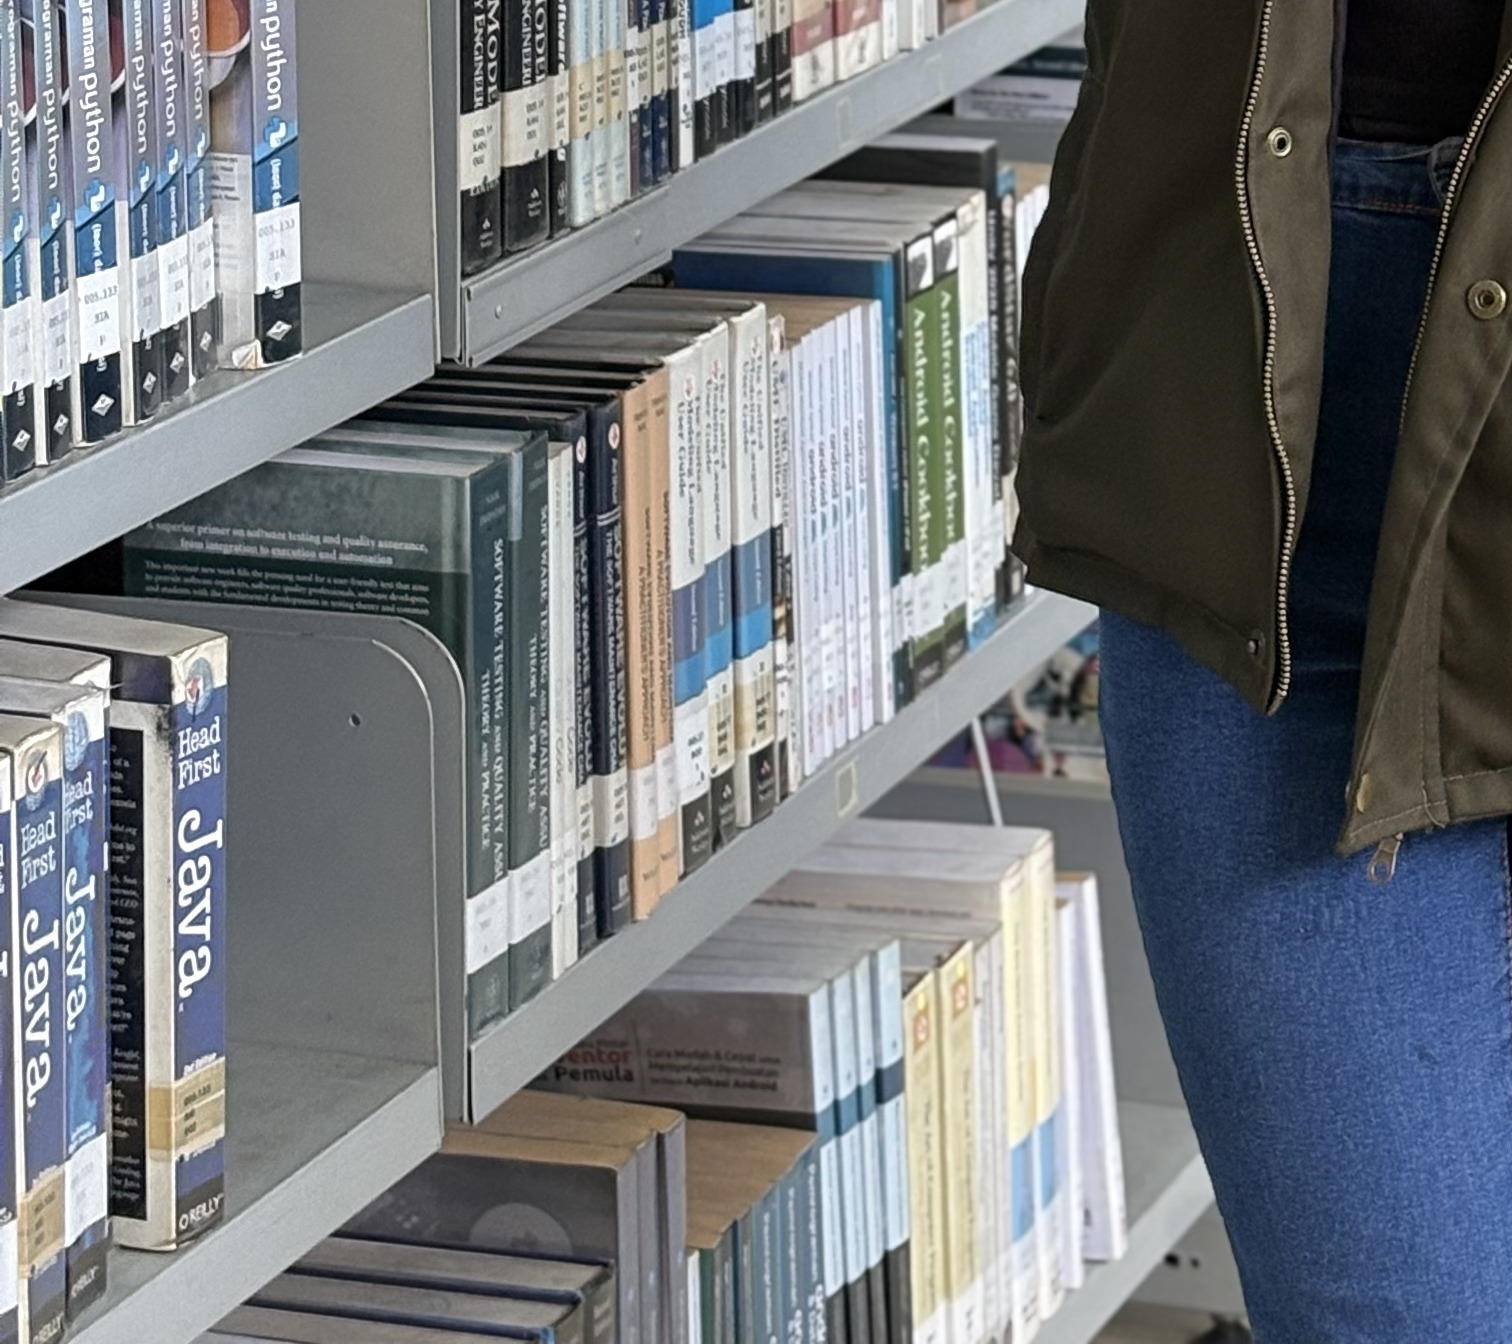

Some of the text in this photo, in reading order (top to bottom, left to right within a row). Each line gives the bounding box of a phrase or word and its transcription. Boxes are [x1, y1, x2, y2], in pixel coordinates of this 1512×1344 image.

[159, 38, 179, 138] python
[188, 24, 206, 120] python
[260, 15, 287, 111] python
[42, 89, 60, 189] python
[79, 73, 103, 173] python
[131, 55, 150, 154] python
[913, 308, 929, 428] Android
[939, 289, 955, 408] Android
[493, 538, 504, 638] SOFTWARE
[493, 640, 504, 719] TESTING
[528, 634, 538, 699] THEORY
[539, 607, 548, 683] TESTING
[178, 717, 221, 759] Head
[480, 671, 491, 735] THEORY
[178, 748, 221, 790] First
[491, 756, 504, 835] QUALITY
[527, 734, 538, 813] PRACTICE
[537, 720, 548, 796] QUALITY
[20, 811, 56, 854] Head
[480, 771, 491, 850] PRACTICE
[20, 844, 56, 890] First
[178, 807, 223, 998] Java
[66, 865, 96, 1031] Java
[23, 908, 58, 1109] Java
[554, 1065, 634, 1083] Pemula
